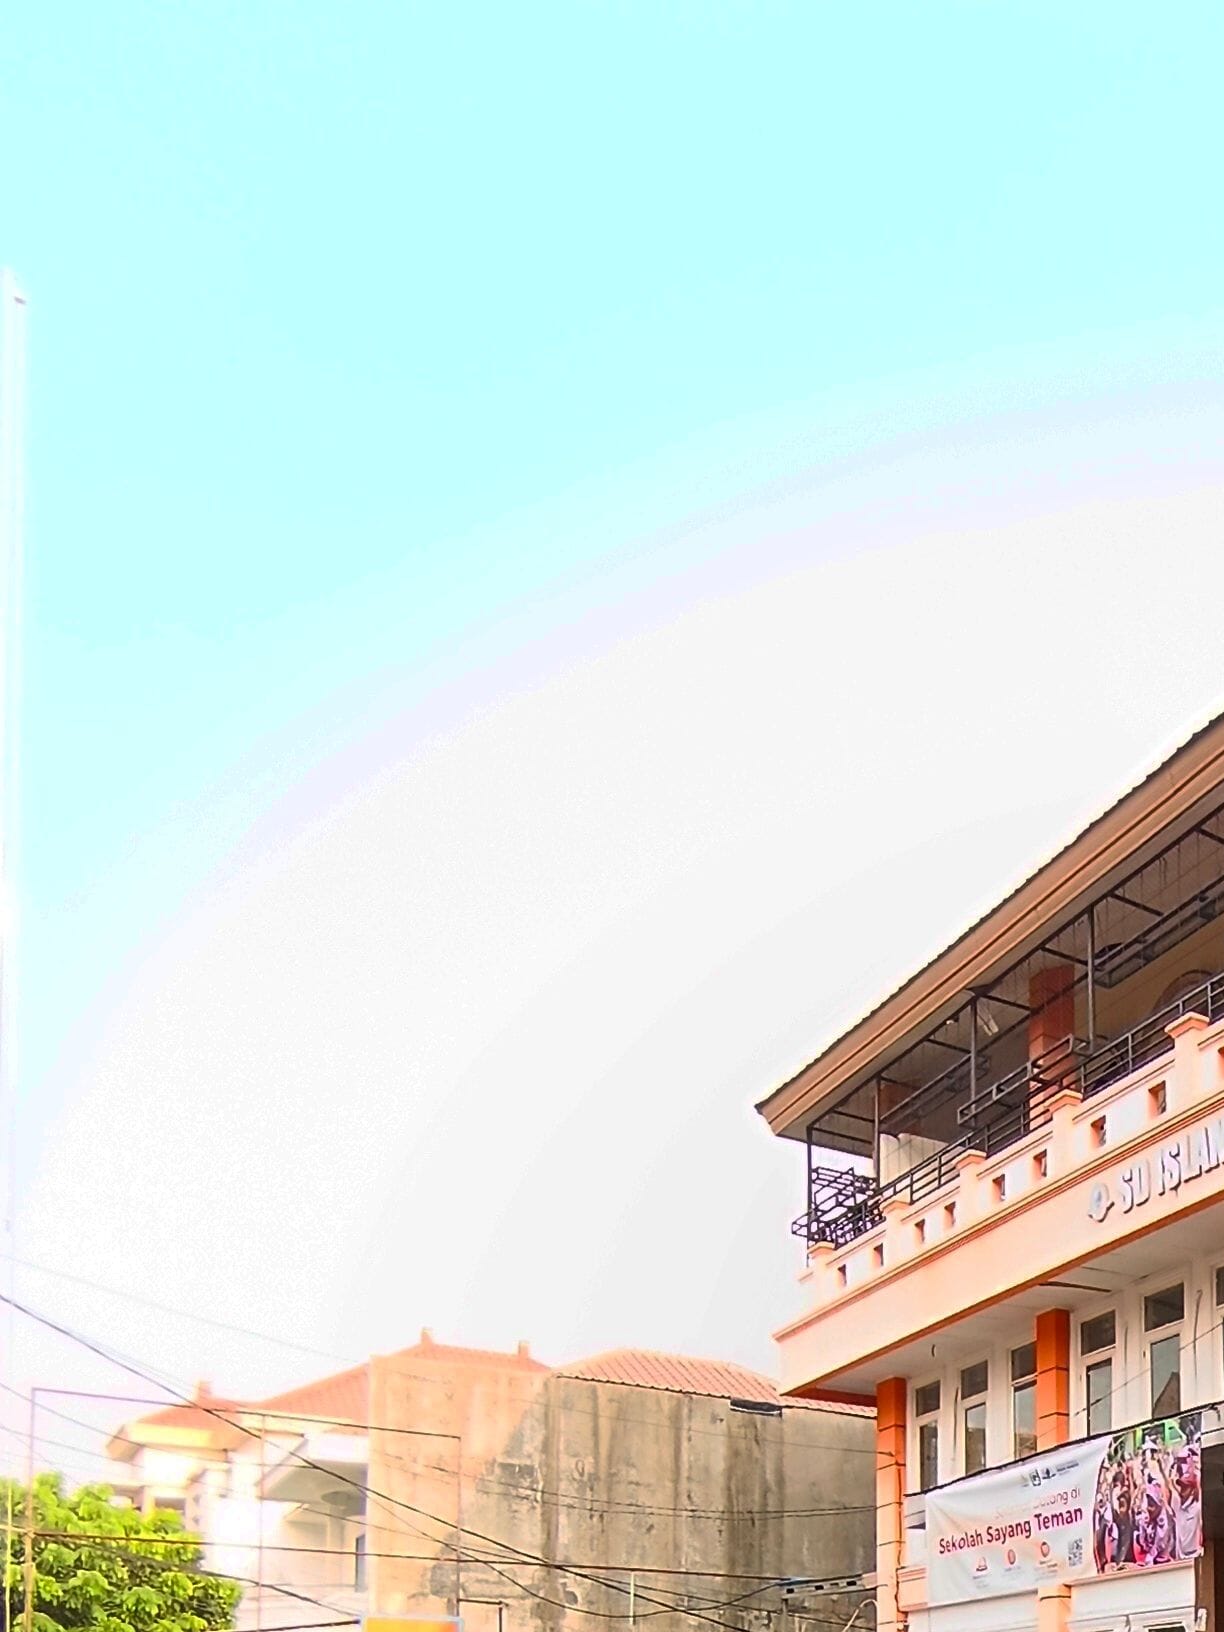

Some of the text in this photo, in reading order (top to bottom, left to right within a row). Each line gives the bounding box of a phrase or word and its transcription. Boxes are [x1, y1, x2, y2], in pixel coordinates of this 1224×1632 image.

[1120, 1157, 1150, 1213] SD
[939, 1529, 983, 1554] Sekolah
[987, 1519, 1032, 1544] Sayang
[1034, 1507, 1083, 1531] Teman
